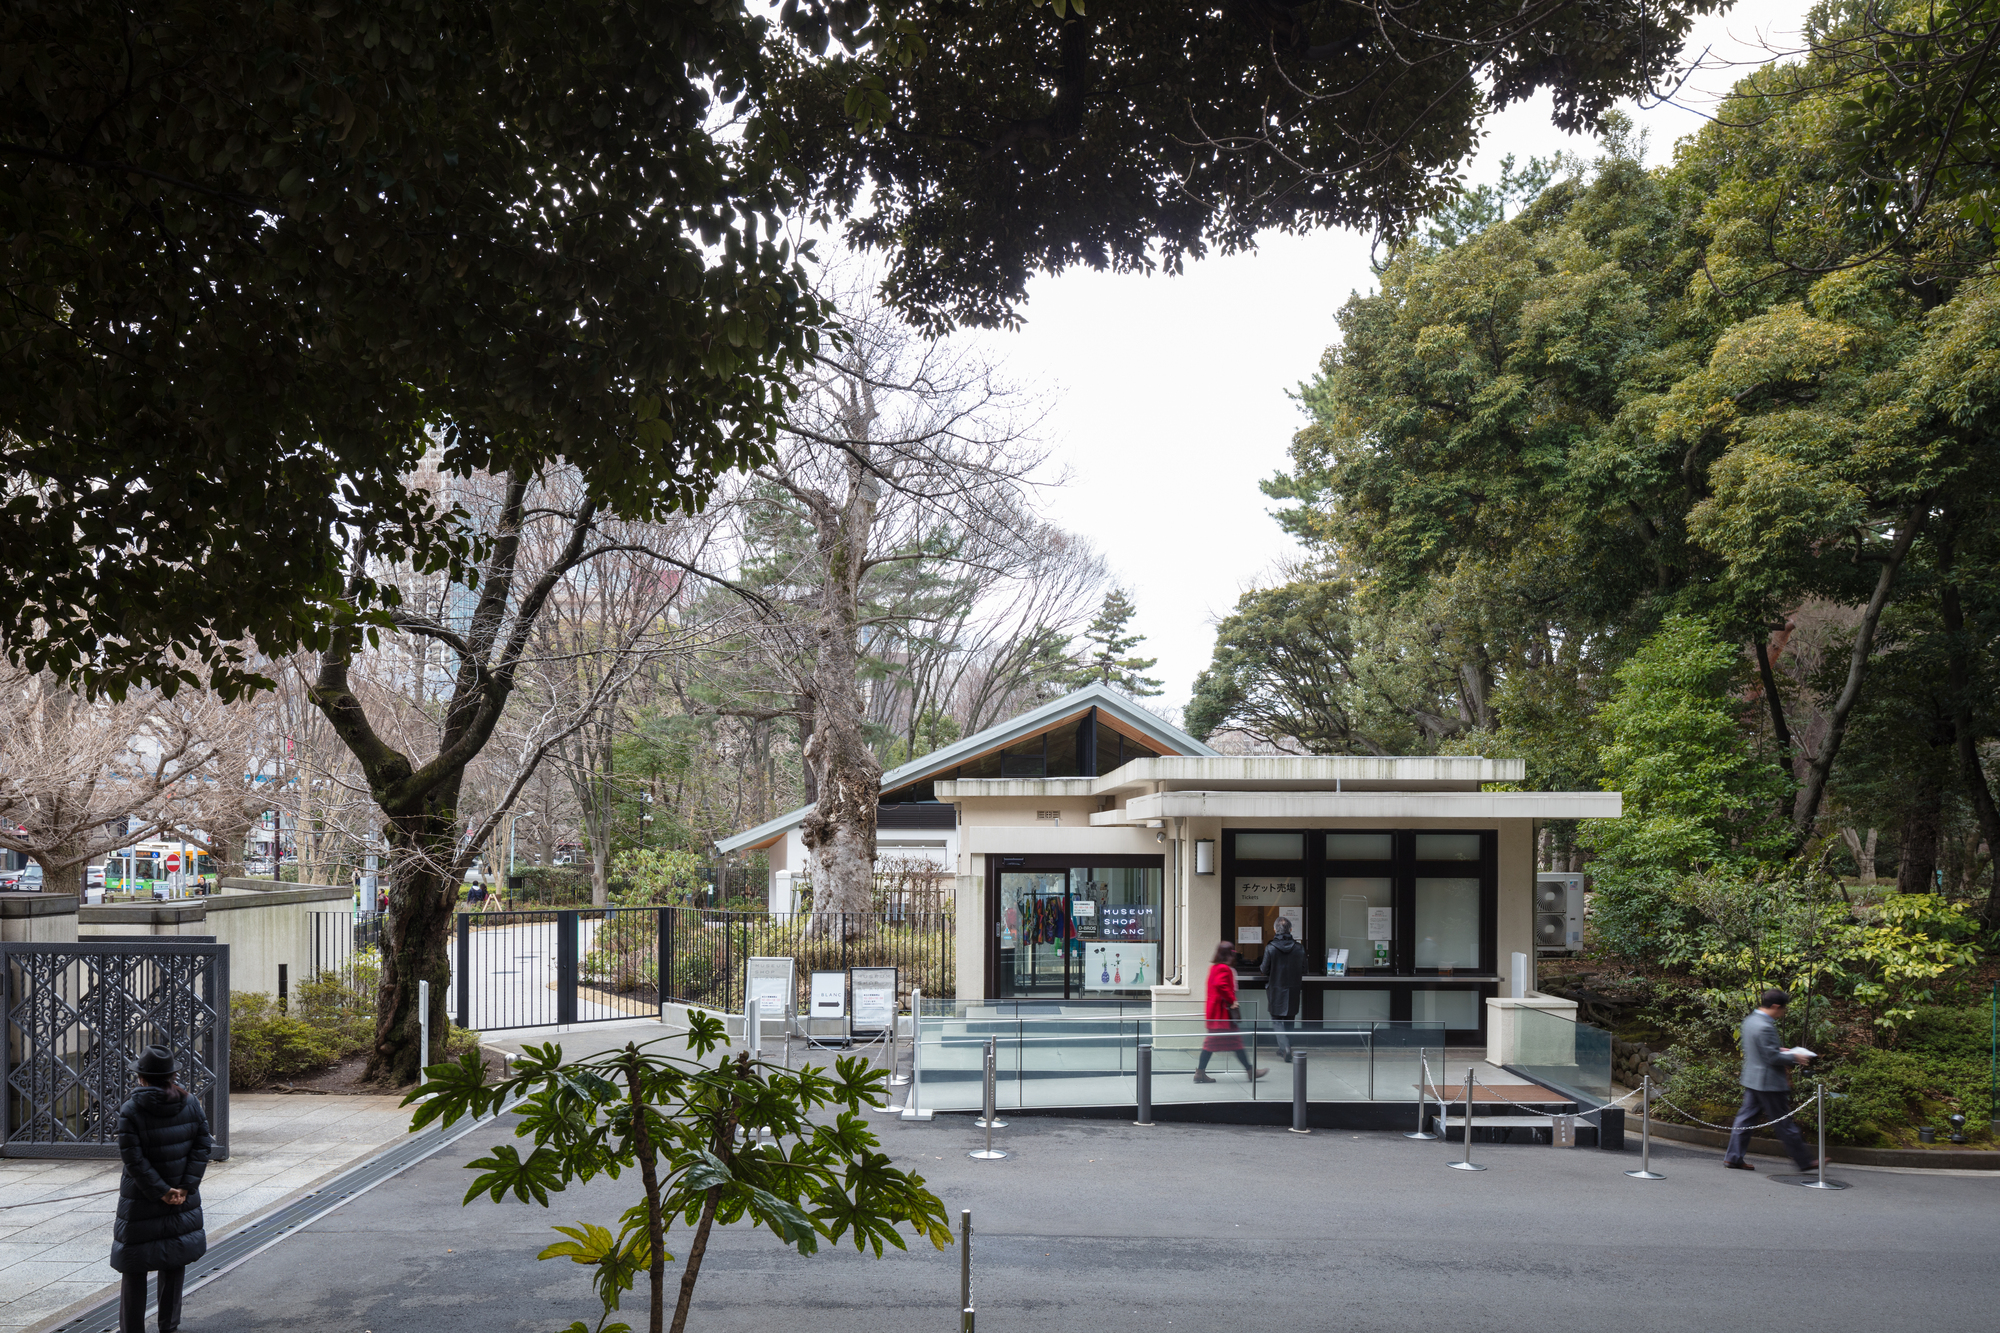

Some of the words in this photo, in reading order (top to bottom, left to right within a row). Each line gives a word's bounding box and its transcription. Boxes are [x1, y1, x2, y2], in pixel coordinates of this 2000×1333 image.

[1242, 883, 1296, 893] チケット売場
[1104, 918, 1136, 926] SHOP
